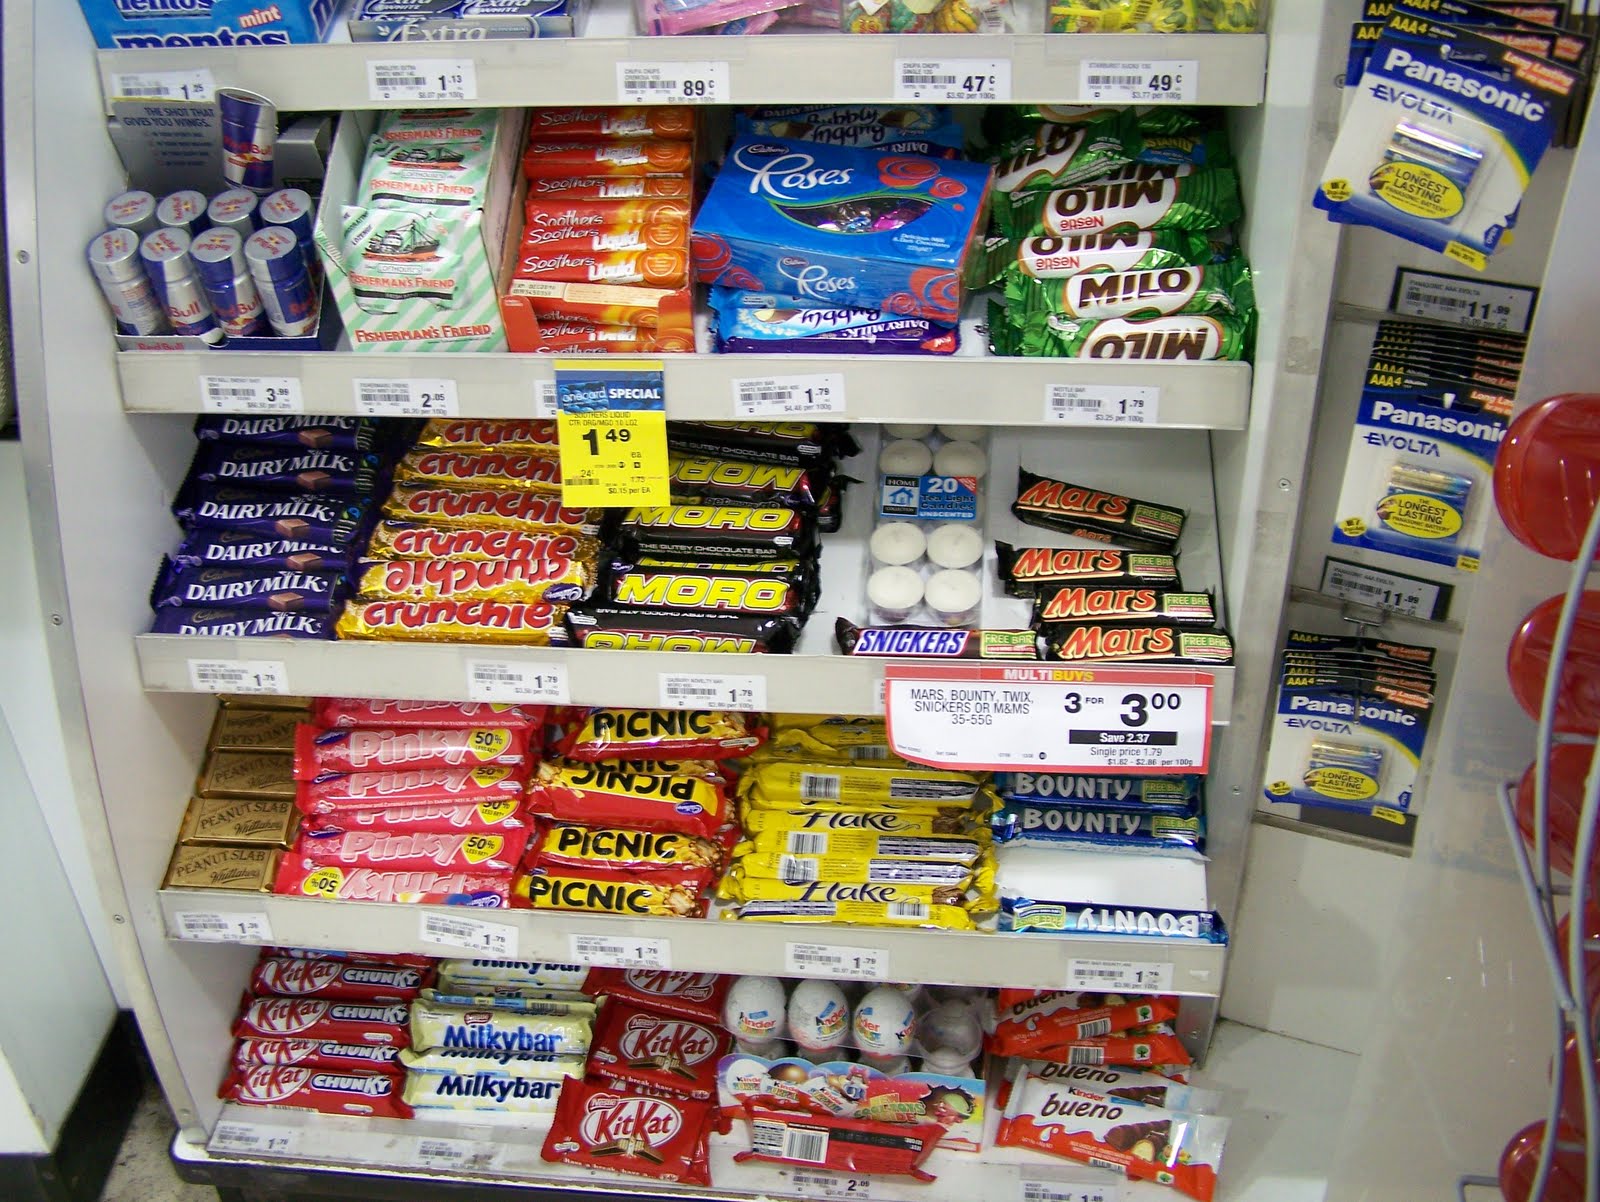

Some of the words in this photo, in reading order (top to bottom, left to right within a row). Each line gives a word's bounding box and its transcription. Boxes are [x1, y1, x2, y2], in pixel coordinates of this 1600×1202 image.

[238, 5, 282, 28] mint
[399, 23, 487, 41] Extra
[684, 80, 704, 97] 89
[963, 76, 986, 91] 47
[1149, 75, 1172, 91] 49
[1384, 48, 1545, 122] Panasonic
[144, 107, 163, 117] THE
[165, 108, 190, 117] SHOT
[191, 108, 215, 117] THAT
[1369, 83, 1453, 124] EVOLTA
[124, 117, 152, 126] GIVES
[153, 118, 174, 126] YOU
[538, 110, 607, 126] Soothers
[445, 125, 483, 138] FRIEND
[733, 143, 855, 200] Roses
[1395, 168, 1450, 194] LONGEST
[435, 180, 475, 195] FRIEND
[537, 176, 606, 192] Soothers
[1393, 178, 1443, 204] LASTING
[1056, 178, 1164, 217] MILO
[534, 210, 603, 226] Soothers
[528, 227, 599, 244] Soothers
[523, 255, 595, 273] Soothers
[415, 277, 455, 288] FRIEND
[776, 258, 855, 300] Roses
[1078, 269, 1191, 309] MILO
[354, 326, 441, 343] FISHERMAN'S
[441, 324, 492, 338] FRIEND
[1090, 328, 1208, 360] MILO
[562, 387, 606, 402] onecard
[609, 387, 661, 400] SPECIAL
[222, 416, 290, 435] DAIRY
[290, 415, 355, 429] MILK
[574, 411, 608, 419] SOOTHERS
[1363, 432, 1440, 457] EVOLTA
[219, 458, 288, 478] DAIRY
[288, 451, 355, 473] MILK
[780, 453, 800, 463] BAR
[928, 477, 959, 494] 20
[921, 494, 940, 502] Tea
[944, 494, 975, 503] Light
[921, 502, 975, 510] Candles
[1018, 480, 1130, 516] Mars
[1398, 499, 1448, 516] LONGEST
[200, 500, 272, 520] DAIRY
[268, 497, 336, 523] MILK
[624, 505, 795, 532] MORO
[919, 511, 975, 519] UNSCENTED
[1398, 508, 1443, 525] LASTING
[205, 541, 278, 561] DAIRY
[393, 529, 577, 561] crunchie
[695, 545, 754, 554] CHOCOLATE
[755, 547, 777, 555] BAR
[1012, 548, 1122, 578] Mars
[1132, 556, 1154, 565] FREE
[186, 580, 258, 601] DAIRY
[258, 571, 329, 593] MILK
[386, 558, 569, 596] crunchie
[617, 573, 792, 611] MORO
[1042, 588, 1156, 619] Mars
[1167, 596, 1190, 605] FREE
[179, 621, 250, 637] DAIRY
[250, 612, 322, 635] MILK
[363, 600, 555, 630] crunchie
[858, 630, 969, 654] SNICKERS
[985, 634, 1009, 644] FREE
[1057, 626, 1174, 659] Mars
[1184, 637, 1207, 645] FREE
[1004, 669, 1095, 682] MULTIBUYS
[911, 689, 947, 702] MARS,
[951, 689, 999, 703] BOUNTY,
[1003, 690, 1034, 704] TWIX,
[915, 702, 971, 714] SNICKERS
[975, 702, 990, 714] OR
[994, 702, 1030, 714] M&MS
[1064, 692, 1082, 714] 3
[1085, 697, 1105, 705] FOR
[593, 709, 713, 739] PICNIC
[951, 714, 993, 726] 35-55G
[1283, 718, 1352, 735] EVOLTA
[351, 728, 468, 768] Pinky
[1099, 732, 1127, 743] Save
[1127, 733, 1150, 743] 2.37
[1090, 746, 1118, 758] Single
[1119, 746, 1141, 758] price
[1143, 747, 1163, 757] 1.79
[1107, 758, 1129, 767] $1.62
[1135, 758, 1157, 767] $2.86
[1161, 758, 1174, 767] per
[1175, 758, 1194, 767] 100g
[349, 767, 466, 798] Pinky
[1015, 773, 1132, 801] BOUNTY
[1322, 771, 1365, 784] LONGEST
[1322, 778, 1362, 790] LASTING
[200, 802, 252, 829] PEANUT
[252, 801, 289, 814] SLAB
[1024, 808, 1142, 836] BOUNTY
[340, 831, 462, 866] Pinky
[558, 828, 680, 859] PICNIC
[176, 850, 232, 876] PEANUT
[231, 849, 266, 862] SLAB
[529, 876, 653, 913] PICNIC
[800, 880, 902, 903] Flake
[1076, 907, 1200, 938] BOUNTY
[271, 960, 335, 992] KitKat
[342, 967, 421, 989] CHUNKY
[256, 998, 321, 1032] KitKat
[331, 1004, 410, 1025] CHUNKY
[739, 1011, 777, 1029] Kinder
[443, 1024, 565, 1054] Milkybar
[636, 1020, 710, 1061] KitKat
[320, 1042, 399, 1063] CHUNKY
[312, 1074, 392, 1096] CHUNKY
[1041, 1063, 1122, 1084] bueno
[436, 1075, 561, 1103] Milkybar
[1068, 1086, 1105, 1102] Kinder
[1041, 1093, 1123, 1120] bueno
[595, 1099, 673, 1142] KitKat
